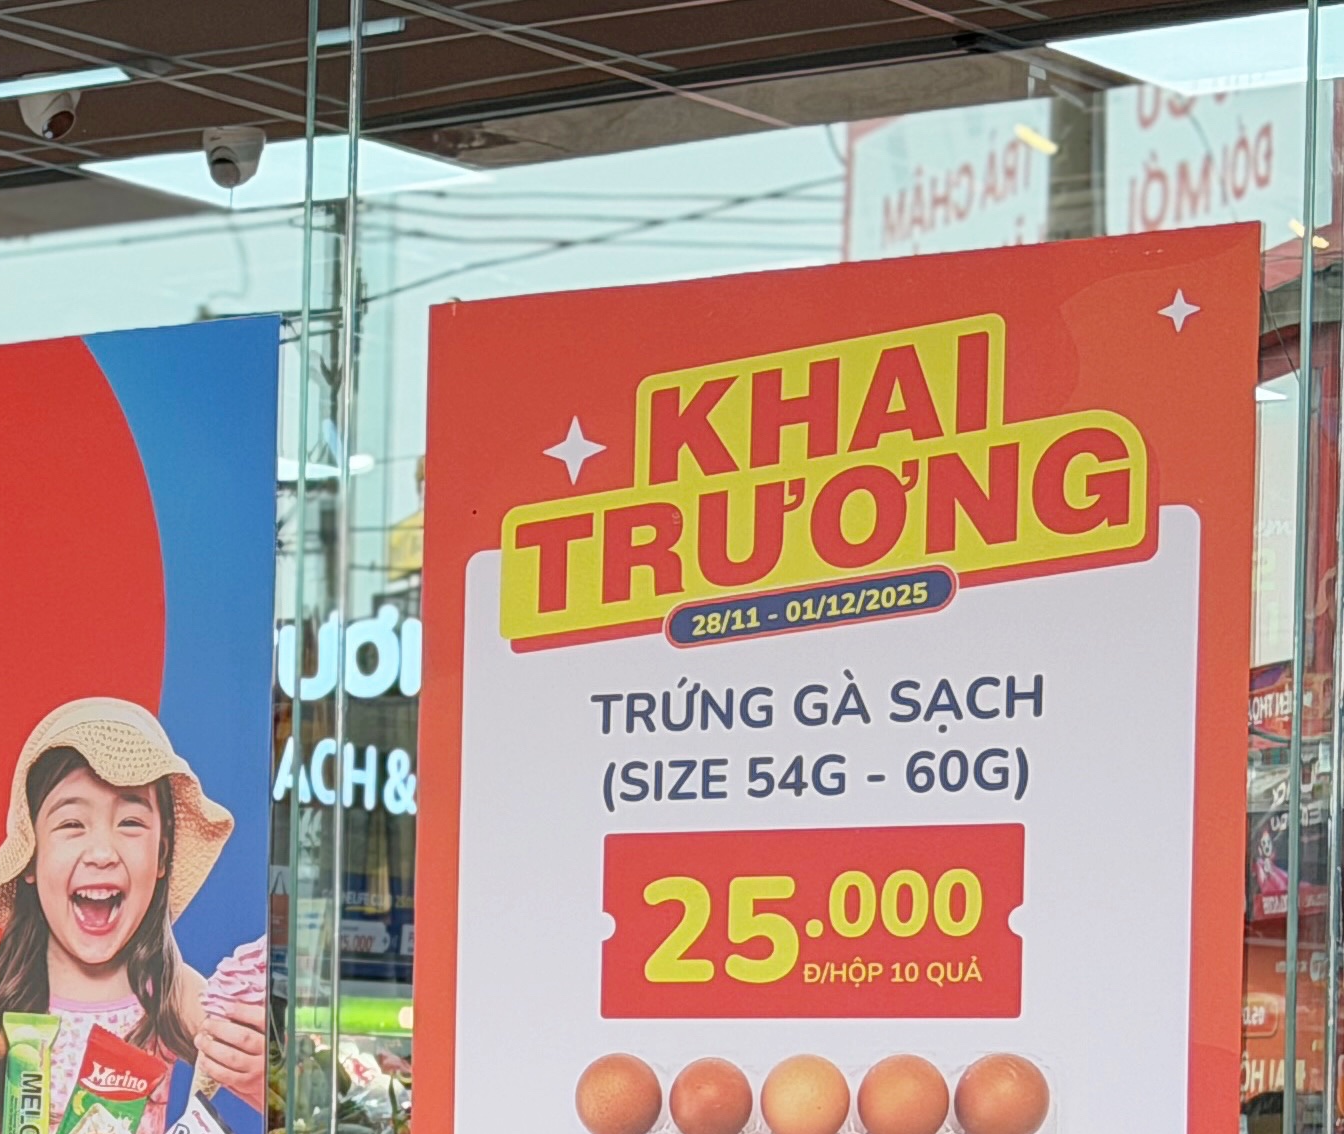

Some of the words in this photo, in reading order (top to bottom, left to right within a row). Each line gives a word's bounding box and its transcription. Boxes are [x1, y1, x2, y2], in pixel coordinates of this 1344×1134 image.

[648, 331, 990, 486] KHAI
[515, 427, 1131, 613] TRƯƠNG
[692, 609, 760, 637] 28/11
[785, 582, 928, 625] 01/12/2025
[274, 604, 422, 700] ƯƠI
[591, 678, 774, 734] TRỨNG
[794, 669, 870, 726] GÀ
[890, 674, 1043, 733] SẠCH
[603, 757, 728, 811] (SIZE
[748, 754, 847, 797] 54G
[906, 748, 1029, 799] 60G)
[643, 868, 983, 983] 25.000
[802, 957, 883, 985] Đ/HỘP
[891, 964, 919, 982] 10
[926, 957, 982, 987] QUẢ
[81, 1061, 147, 1092] Merino
